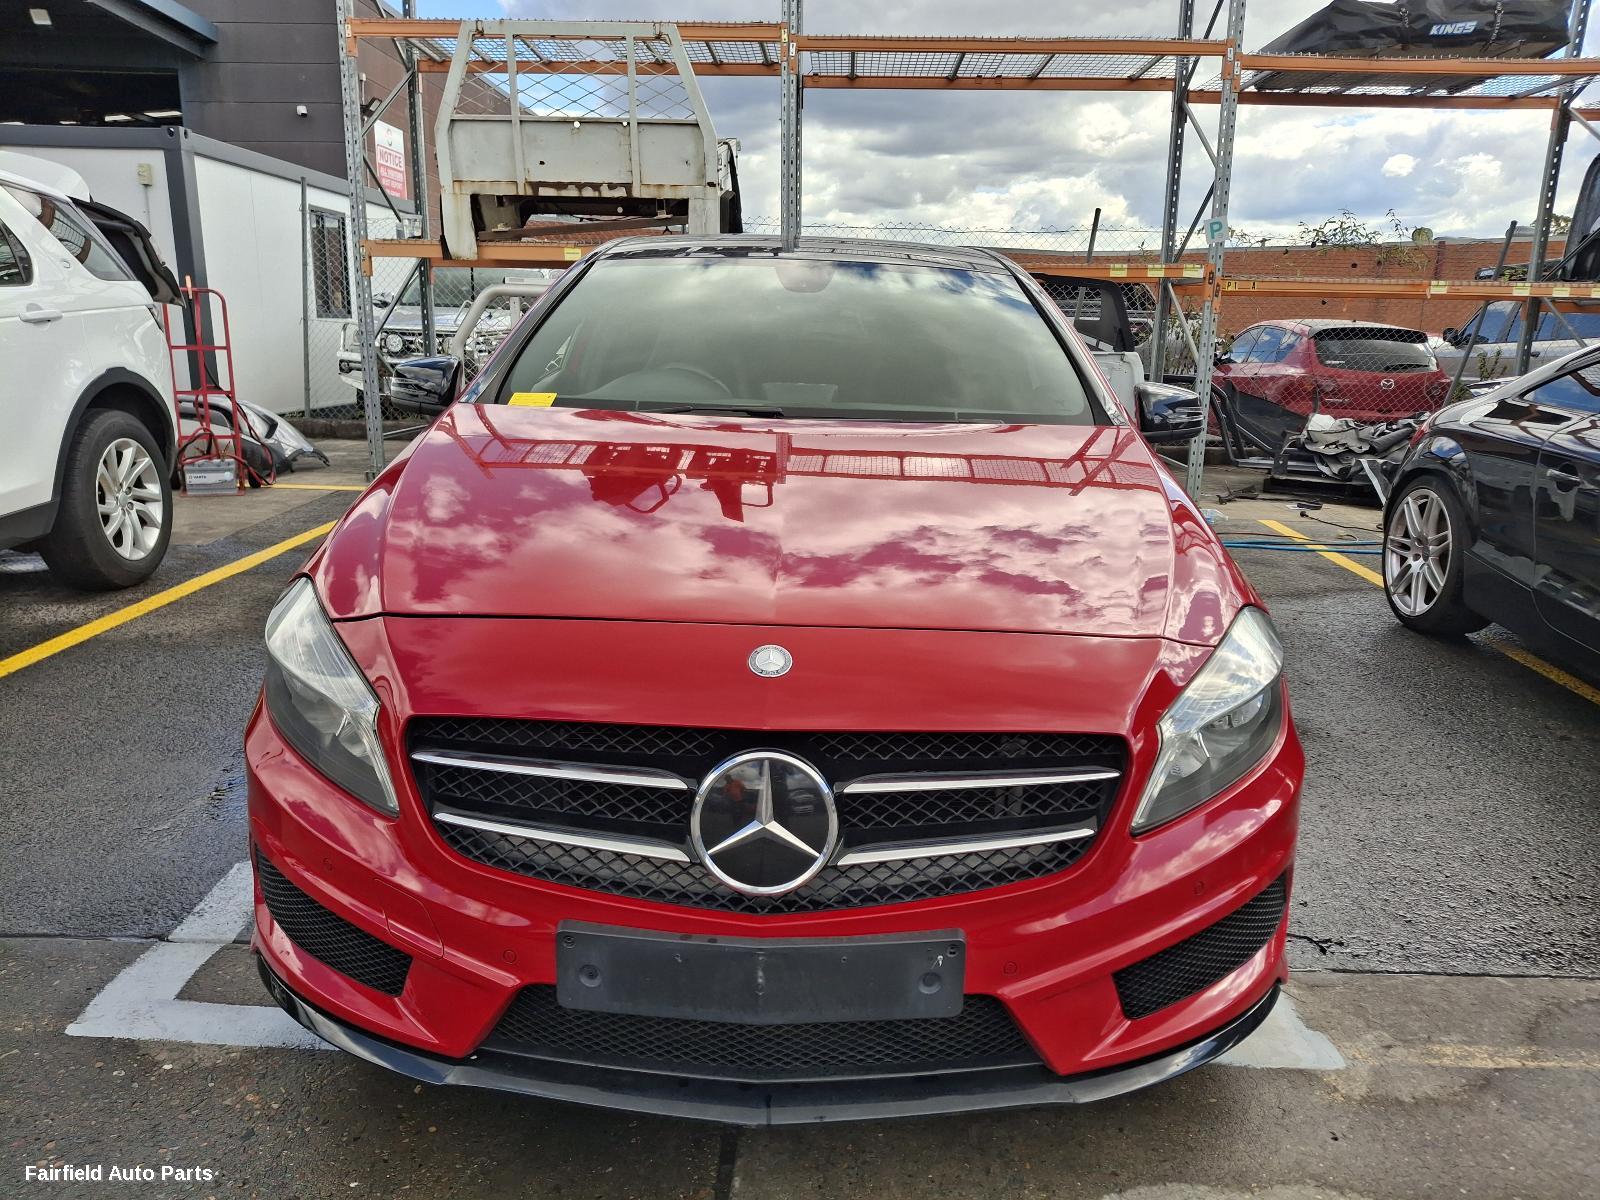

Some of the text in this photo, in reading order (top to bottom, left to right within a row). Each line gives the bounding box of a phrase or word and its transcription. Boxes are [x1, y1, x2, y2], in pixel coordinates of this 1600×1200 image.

[1429, 21, 1478, 36] KINGS
[379, 149, 403, 169] NOTICE
[1209, 221, 1223, 239] P
